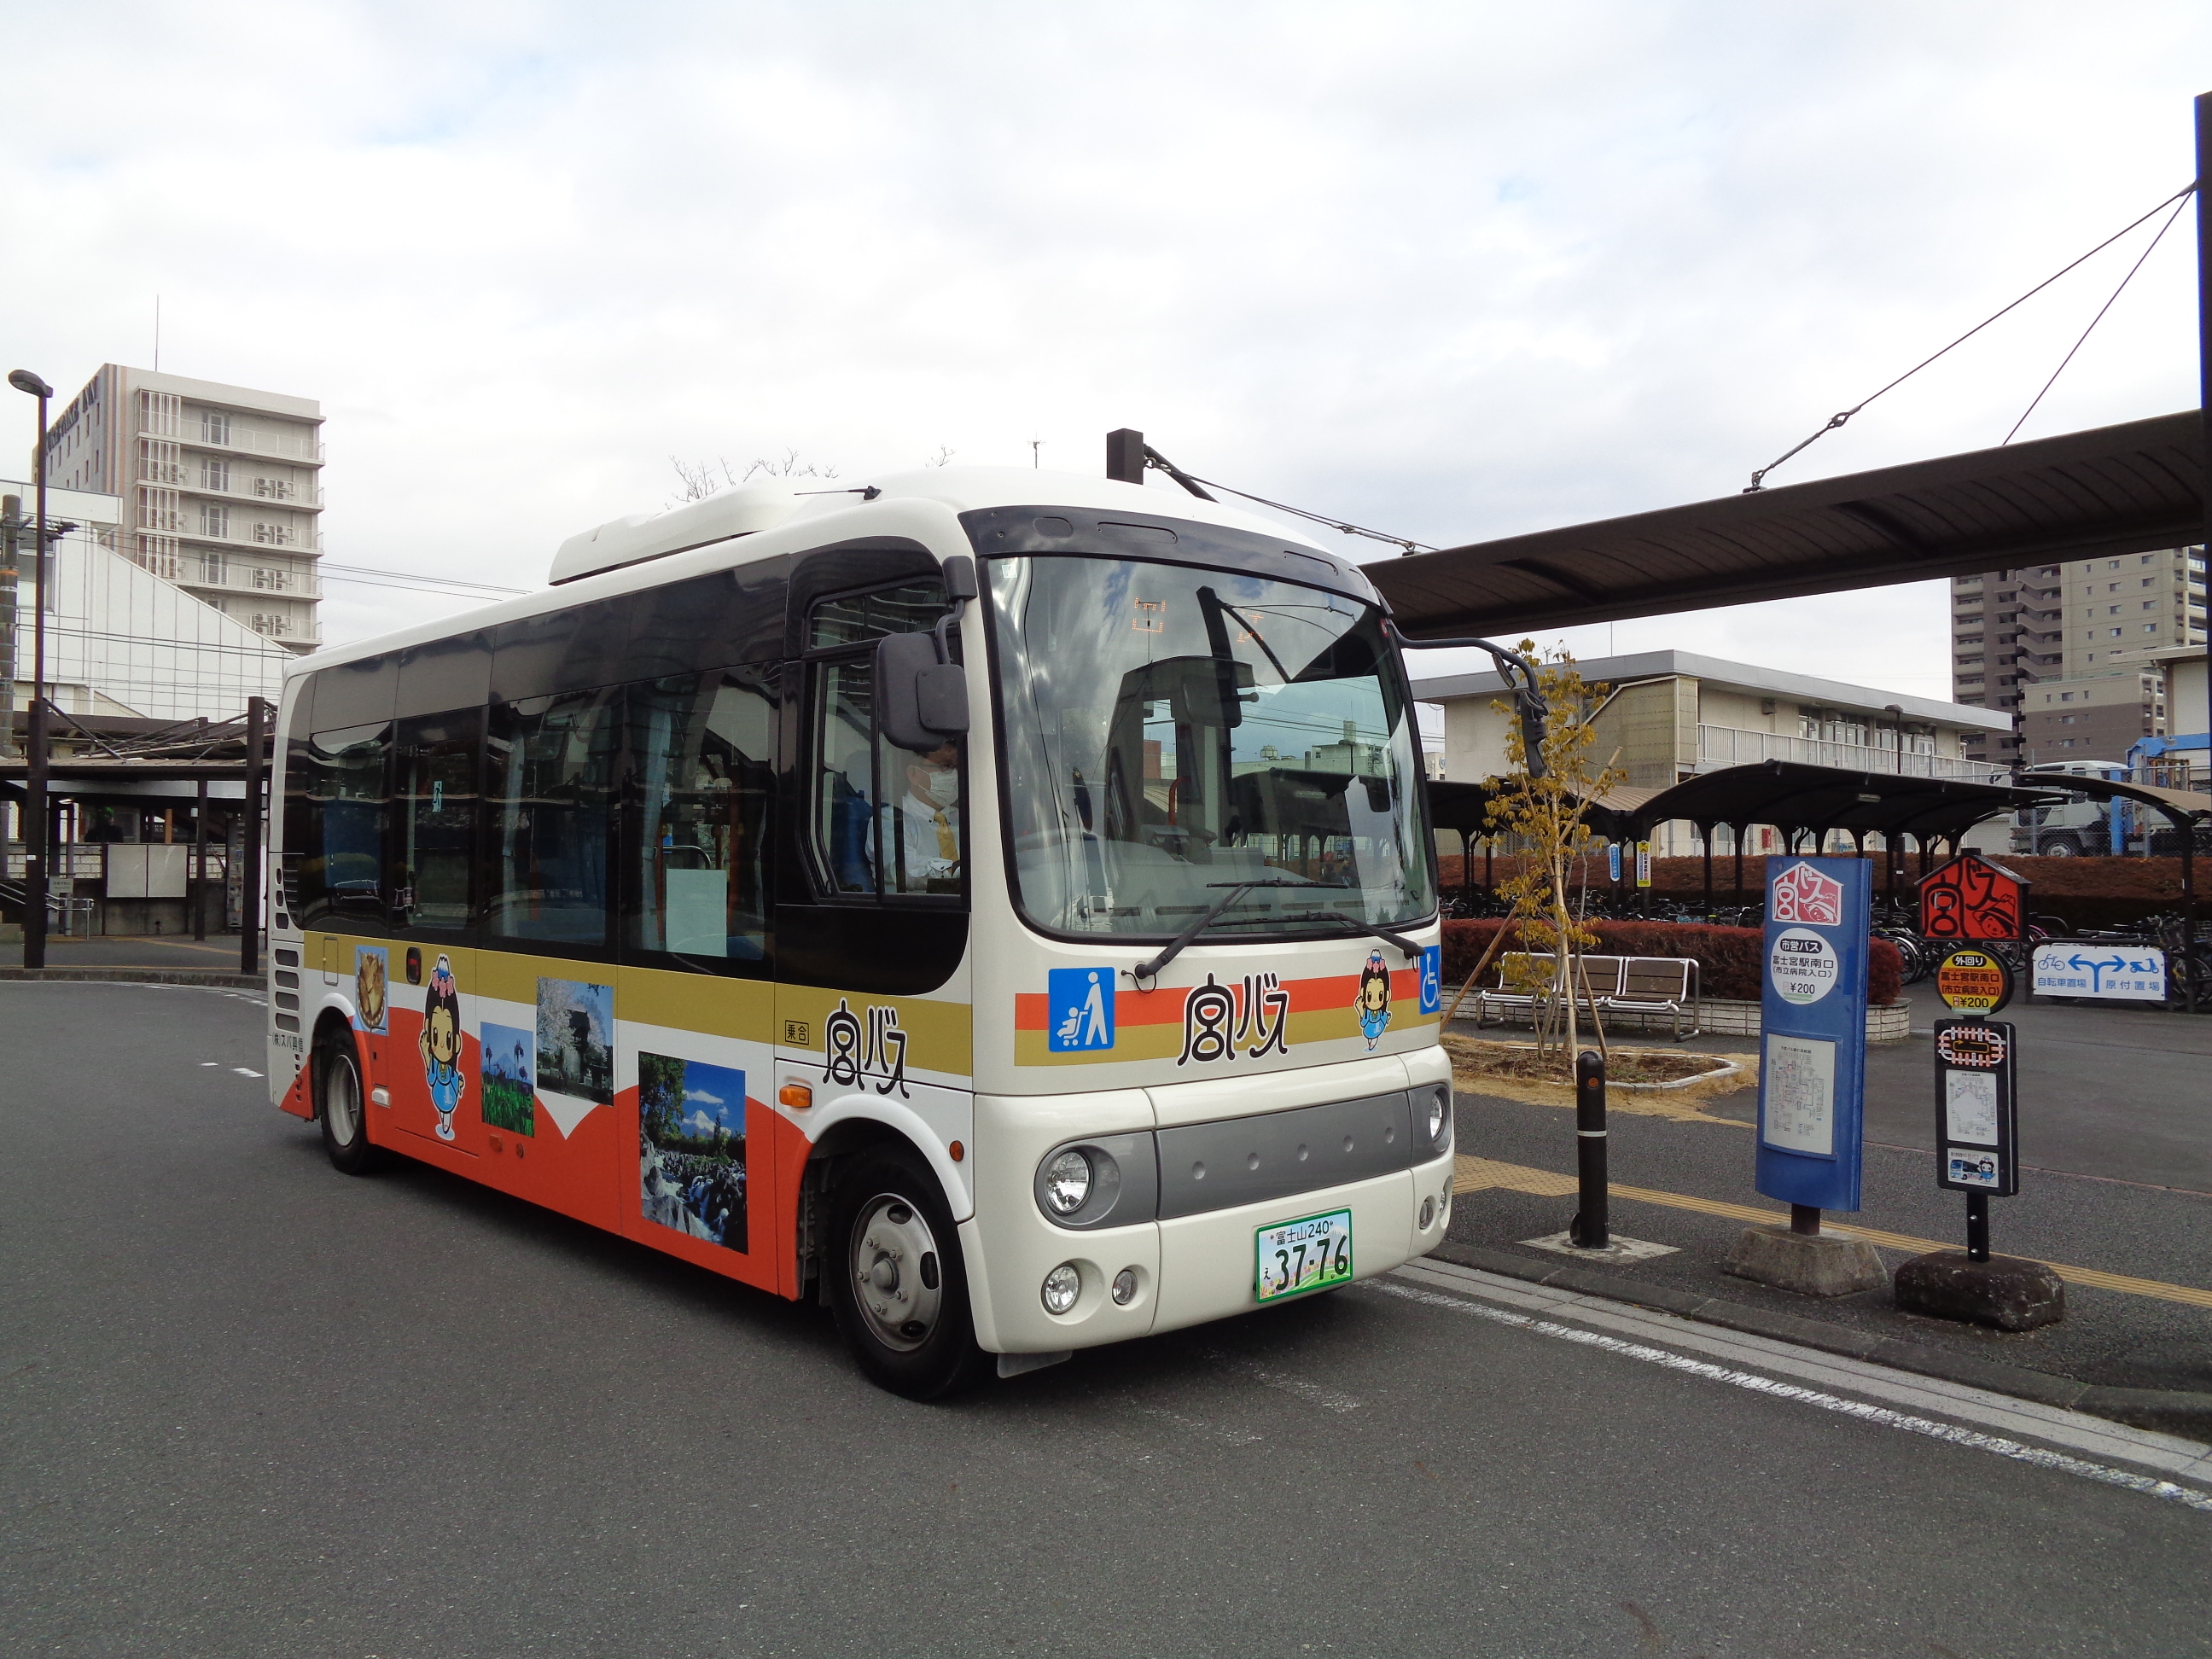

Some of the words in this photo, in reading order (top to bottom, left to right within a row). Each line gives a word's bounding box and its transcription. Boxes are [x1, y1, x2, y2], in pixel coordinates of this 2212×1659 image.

[1781, 940, 1820, 953] 市営バス
[1773, 956, 1834, 969] 富士宮駅南口
[1954, 956, 1983, 966] 外回り
[1941, 972, 2000, 982] 富士宮駅南口
[2037, 977, 2087, 988] 自転車置場
[1790, 982, 1815, 994] ¥200
[1959, 997, 1989, 1008] ¥200
[1178, 972, 1288, 1066] 宮バス
[787, 1024, 807, 1042] 乗合
[822, 999, 910, 1099] 宮バス
[1263, 1267, 1271, 1280] え
[1275, 1235, 1348, 1291] 37-76
